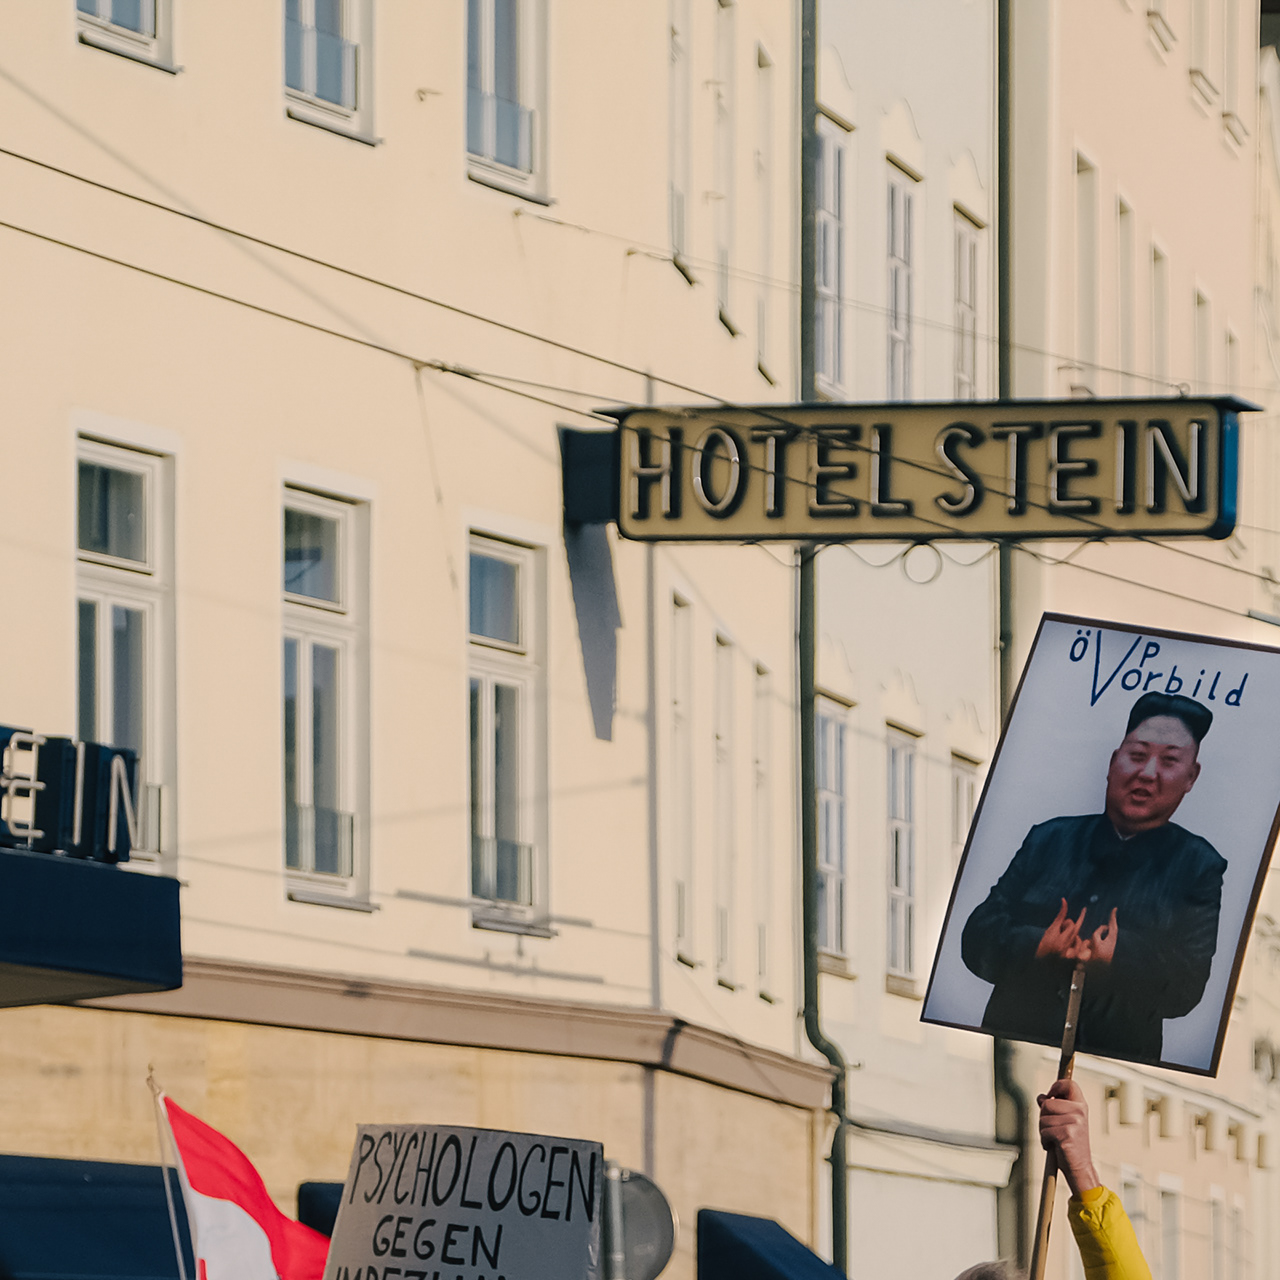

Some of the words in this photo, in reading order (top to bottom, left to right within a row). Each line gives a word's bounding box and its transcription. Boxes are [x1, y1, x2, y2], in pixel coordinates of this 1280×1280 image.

[629, 421, 913, 519] HOTEL
[934, 418, 1210, 517] STEIN
[349, 1131, 596, 1222] PSYCHOLOGEN
[372, 1215, 503, 1269] GEGEN
